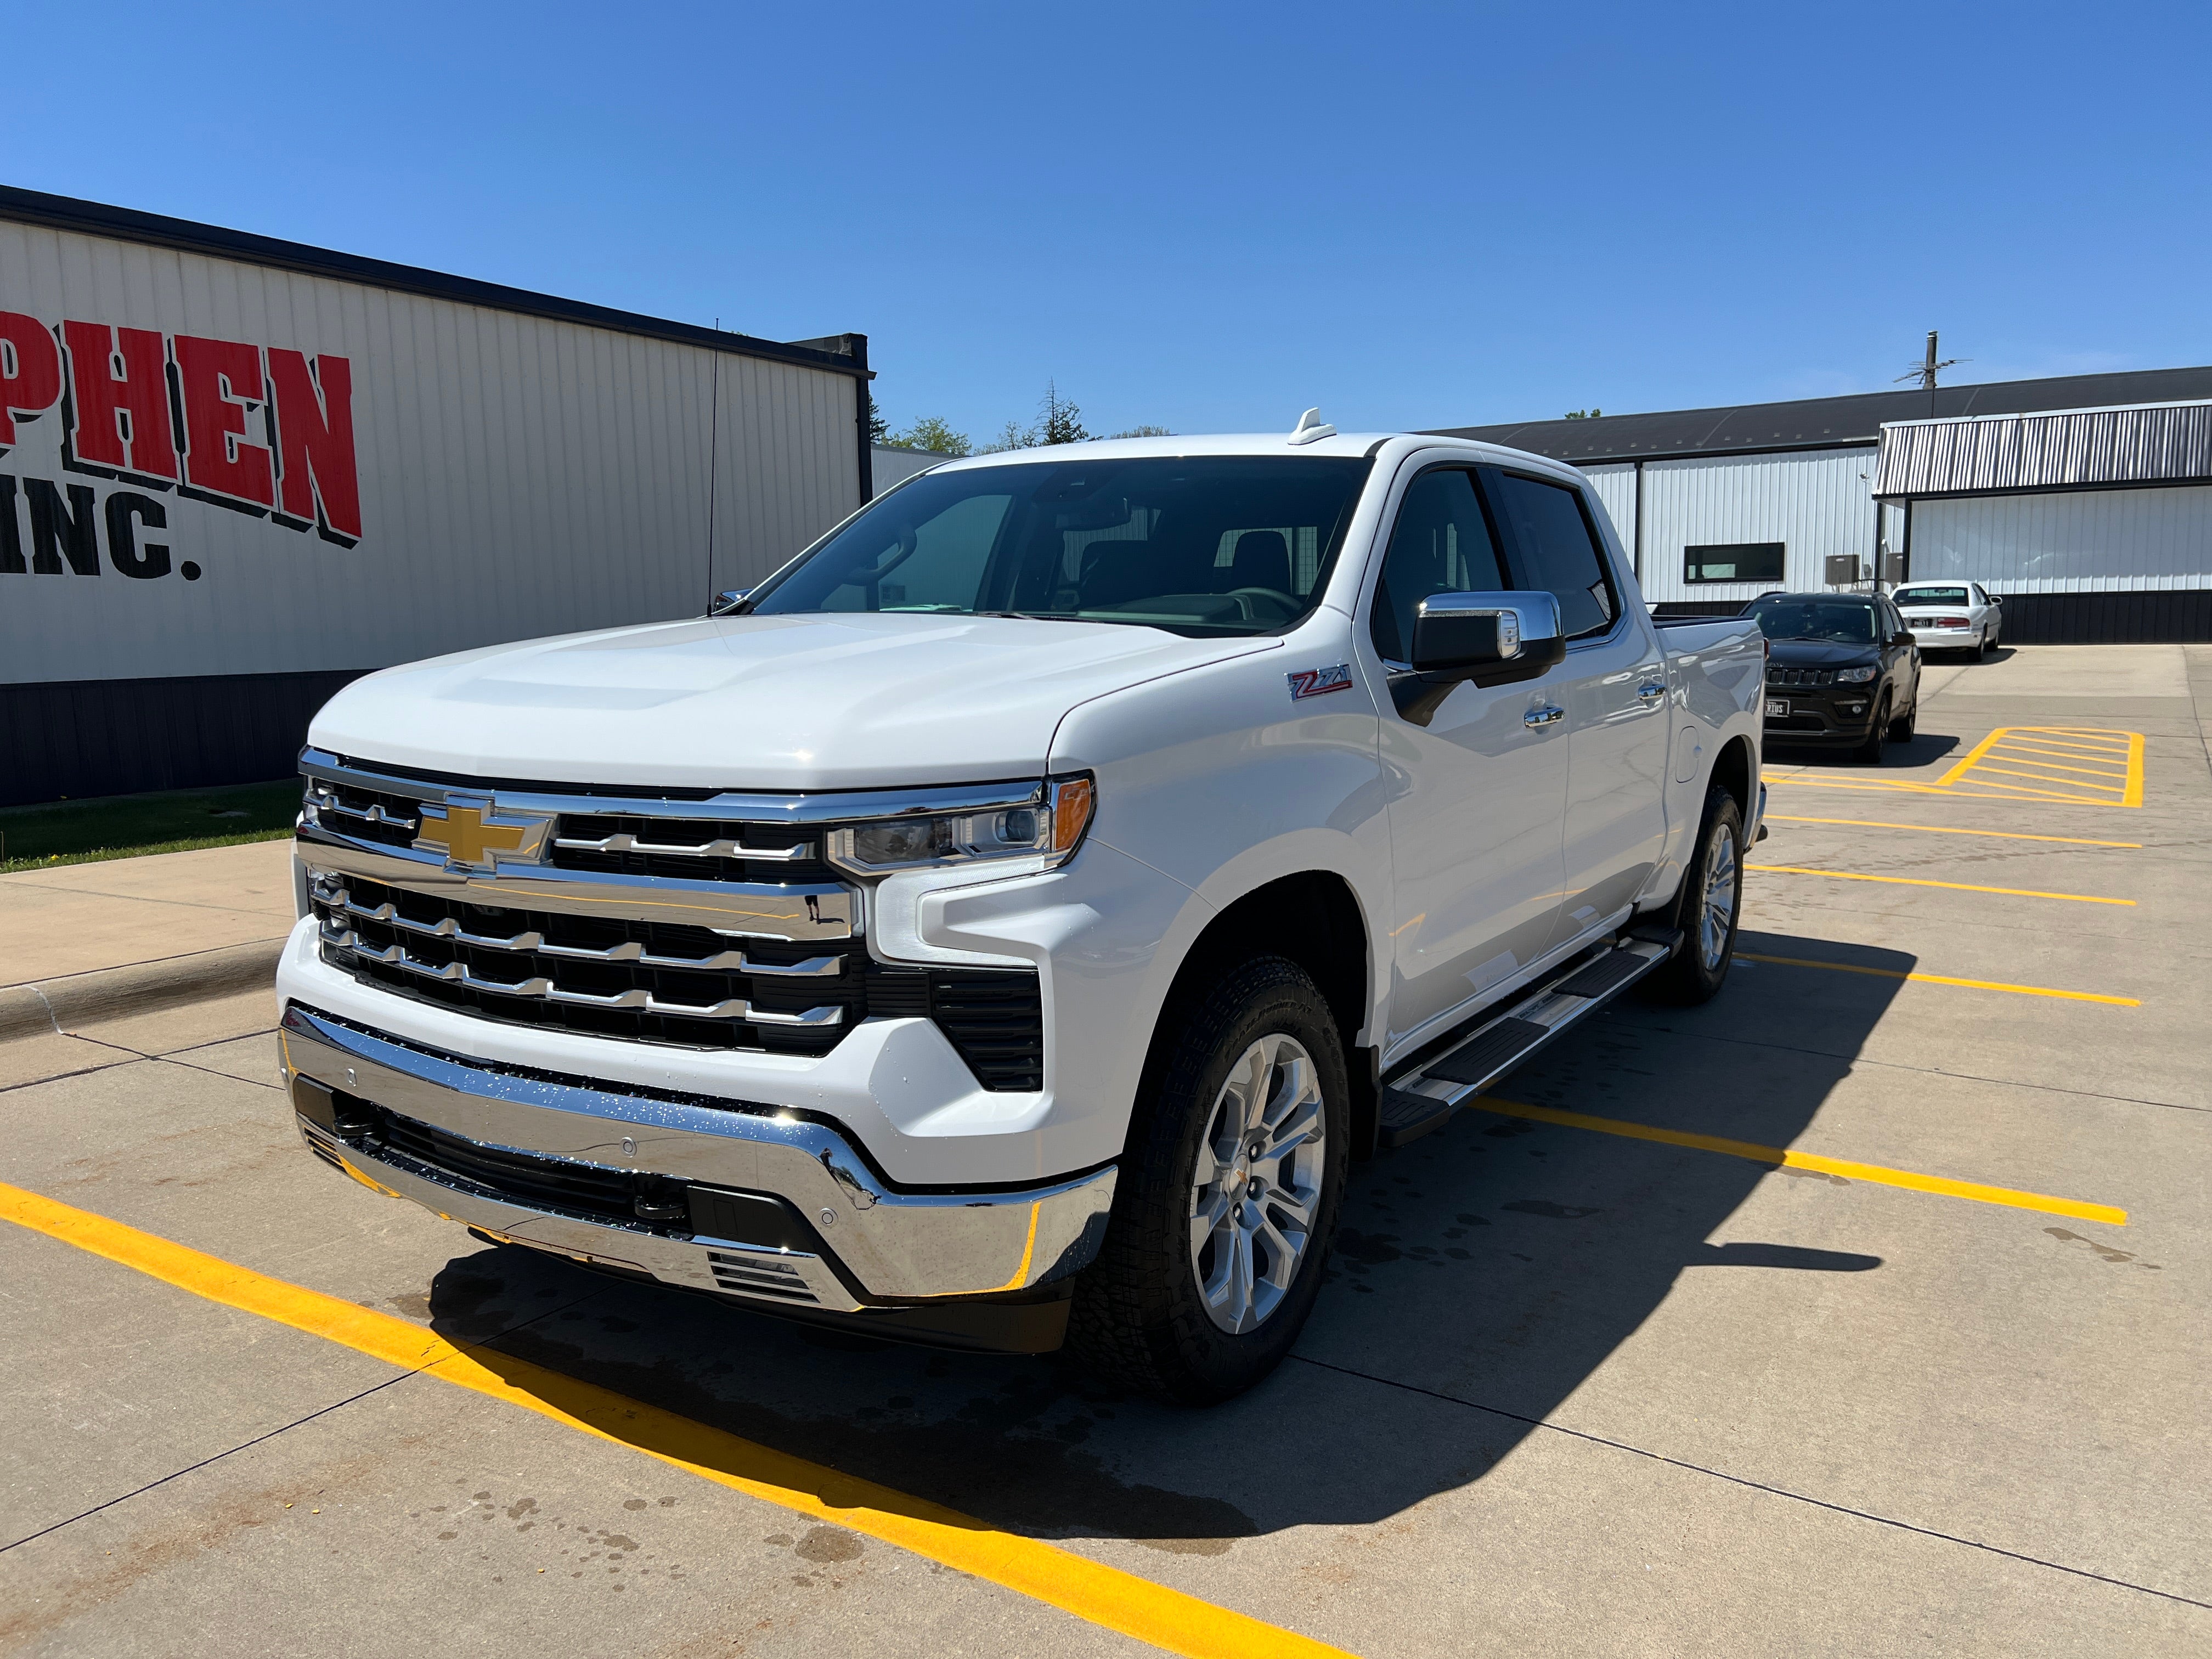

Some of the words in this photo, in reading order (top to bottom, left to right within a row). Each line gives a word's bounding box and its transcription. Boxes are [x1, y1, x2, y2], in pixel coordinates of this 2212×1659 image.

[0, 311, 362, 546] PHEN
[0, 473, 201, 581] INC.
[1287, 664, 1353, 702] Z71
